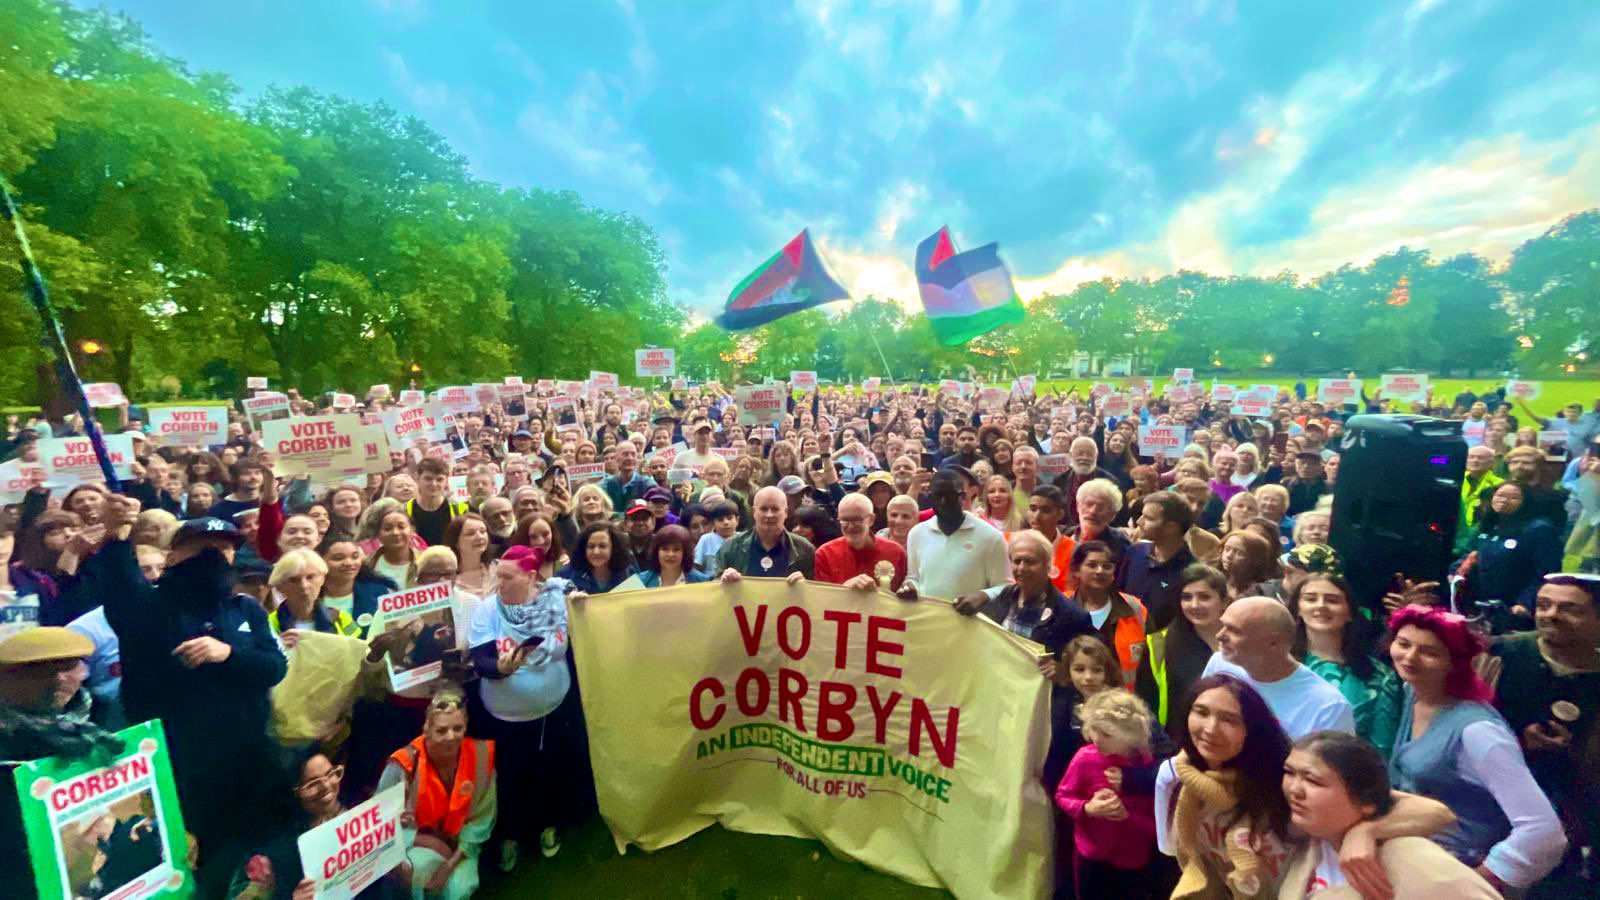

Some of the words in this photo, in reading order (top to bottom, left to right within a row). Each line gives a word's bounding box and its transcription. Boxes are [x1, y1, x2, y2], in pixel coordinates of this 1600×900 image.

[751, 390, 773, 399] VOTE
[161, 422, 218, 433] CORBYN
[171, 411, 208, 421] VOTE
[290, 421, 337, 437] VOTE
[52, 453, 124, 468] CORBN
[278, 435, 352, 454] CORBYN
[382, 584, 450, 612] CORBYN
[734, 605, 907, 679] VOTE
[690, 667, 960, 769] CORBYN
[697, 733, 726, 760] AN
[734, 725, 882, 773] INDEPENDENT
[888, 755, 952, 804] VOICE
[777, 756, 796, 780] FOR
[797, 771, 821, 794] ALL
[824, 779, 844, 795] OF
[847, 781, 866, 798] US
[51, 756, 149, 812] CORBYN
[336, 803, 381, 845] VOTE
[323, 817, 396, 879] CORBYN
